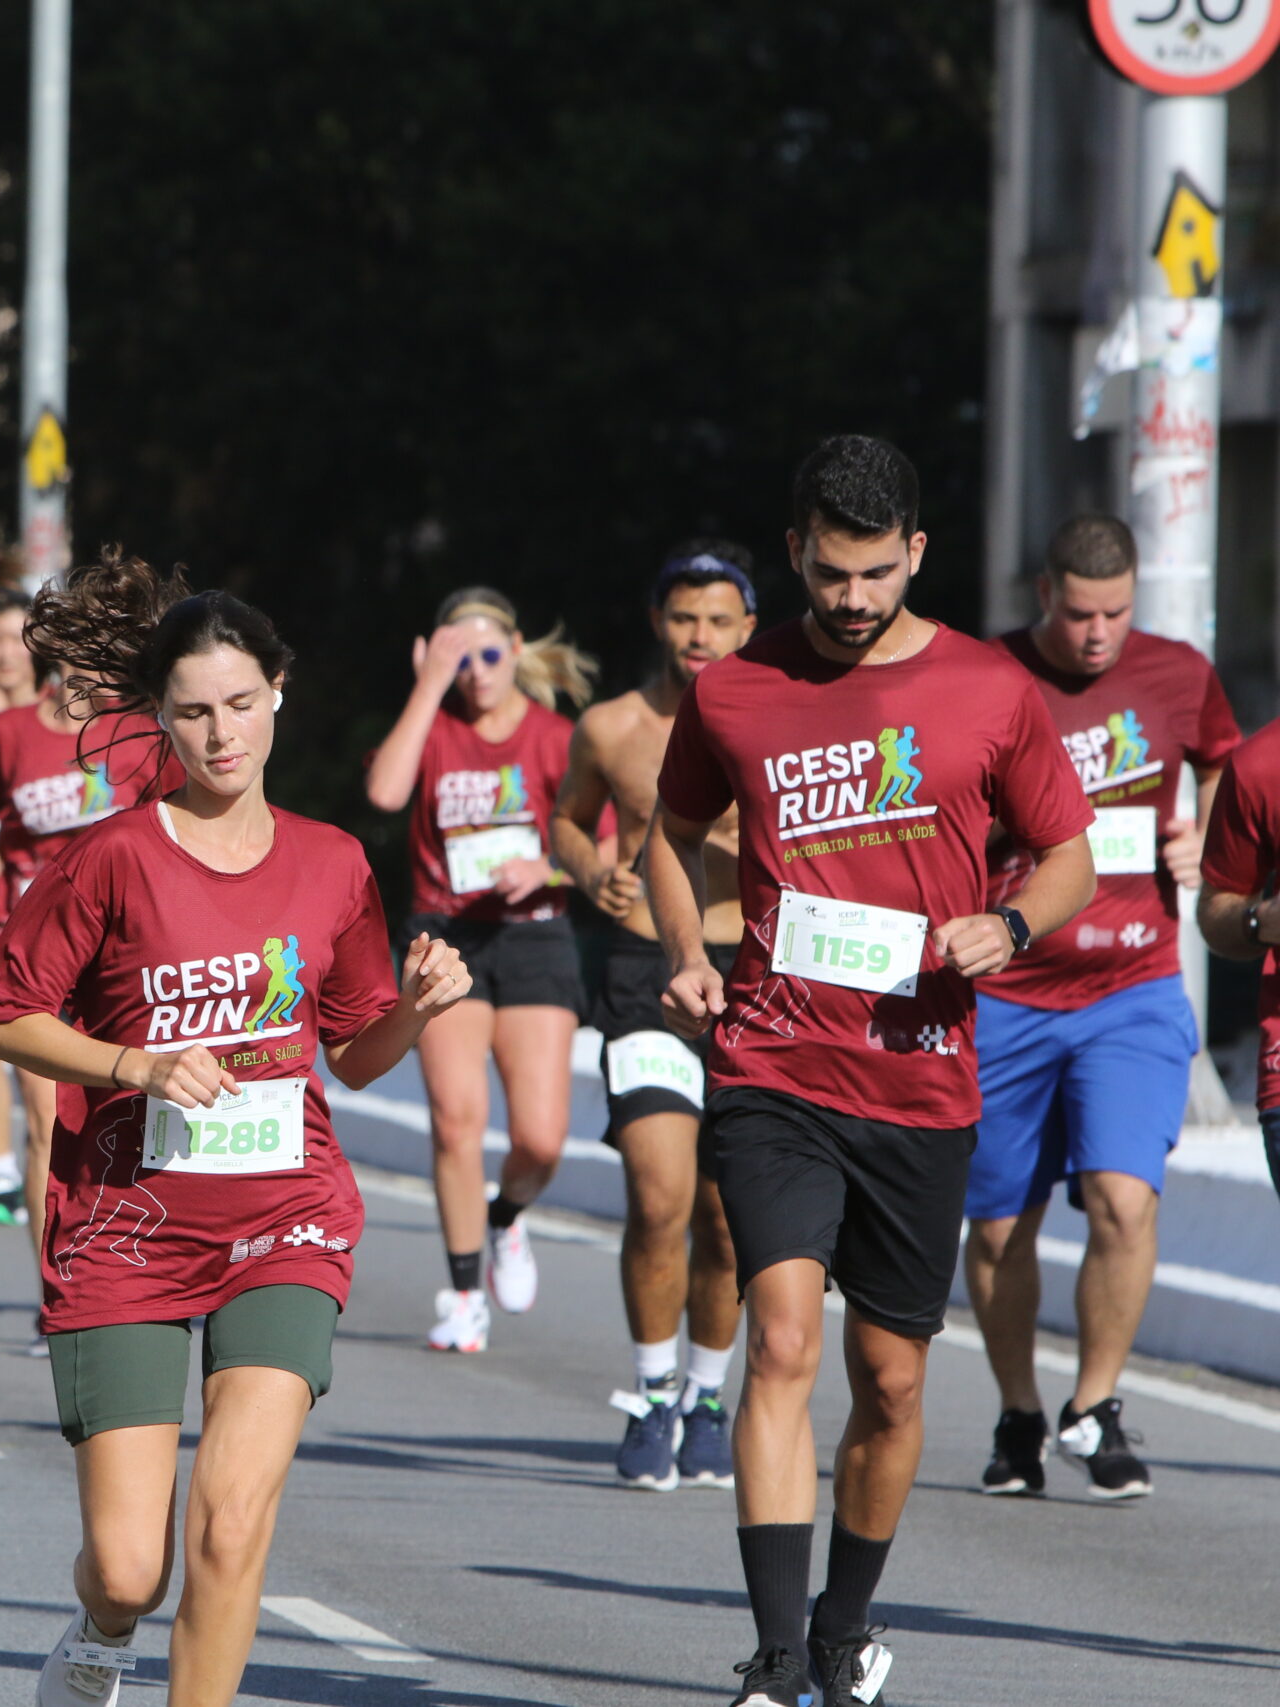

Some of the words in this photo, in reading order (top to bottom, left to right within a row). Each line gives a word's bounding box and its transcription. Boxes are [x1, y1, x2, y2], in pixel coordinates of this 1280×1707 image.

[763, 739, 876, 793] ICESP
[778, 779, 868, 828] RUN
[859, 831, 892, 847] PELA
[897, 824, 937, 841] SAÚDE
[811, 933, 891, 974] 1159
[141, 952, 261, 1004] ICESP
[146, 996, 251, 1040] RUN
[233, 1050, 270, 1067] PELA
[275, 1043, 303, 1061] SAÚDE
[184, 1118, 281, 1154] 1288
[213, 1160, 244, 1168] ISABELLA
